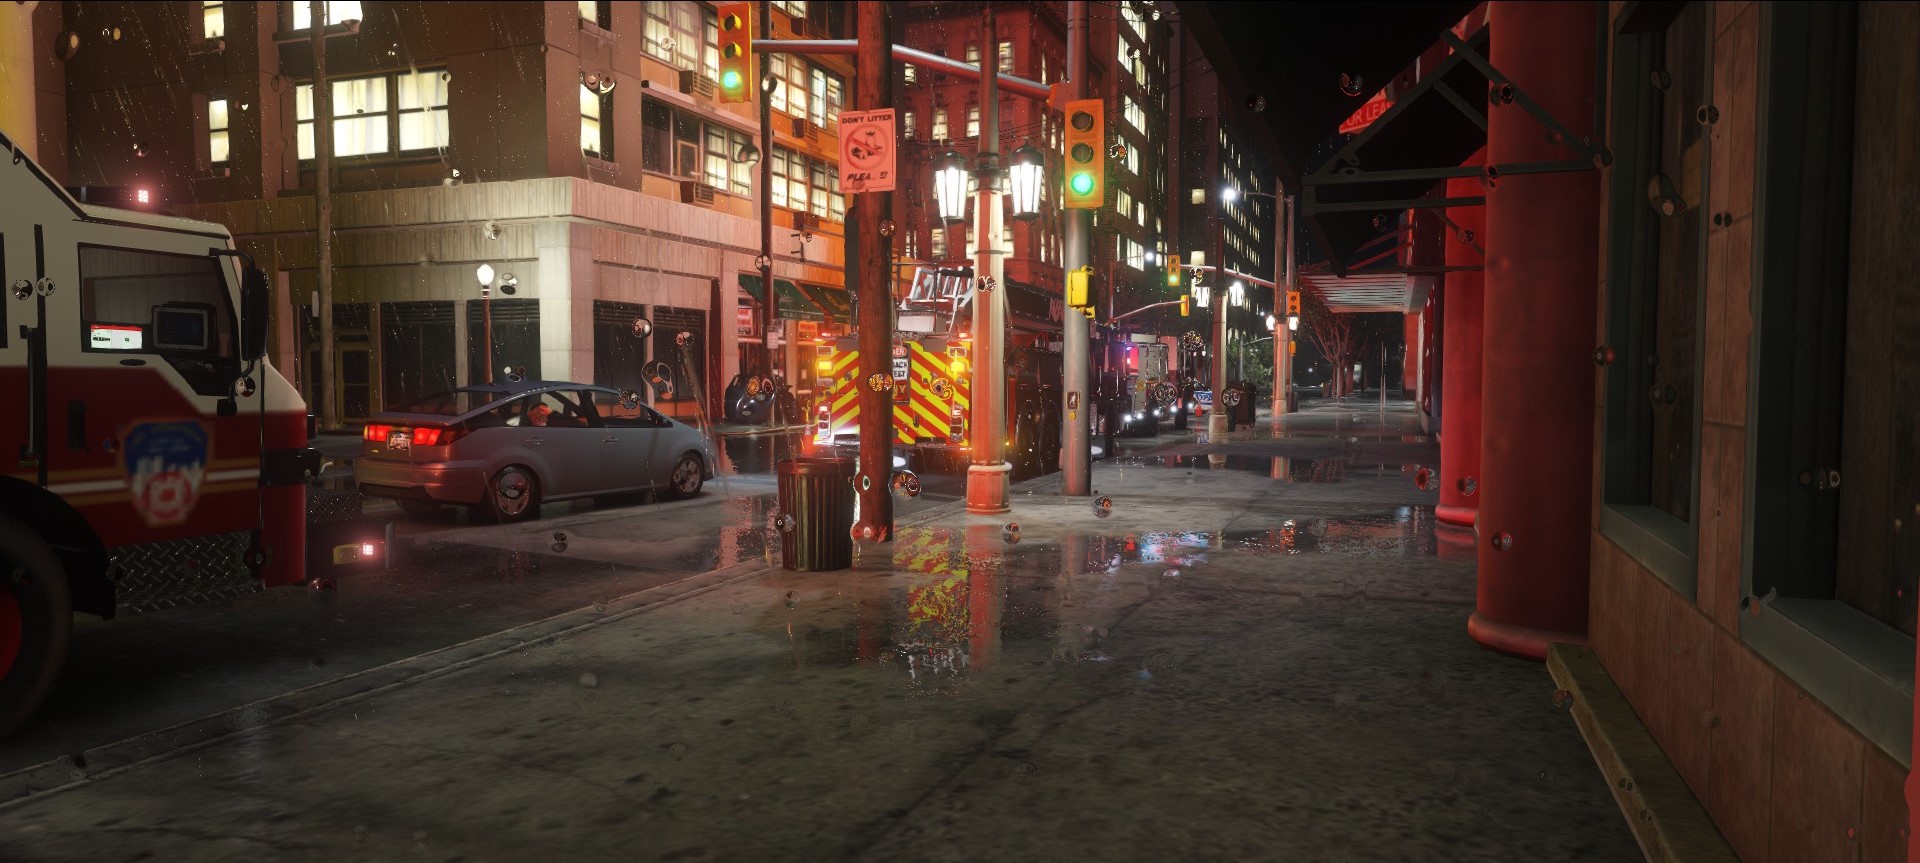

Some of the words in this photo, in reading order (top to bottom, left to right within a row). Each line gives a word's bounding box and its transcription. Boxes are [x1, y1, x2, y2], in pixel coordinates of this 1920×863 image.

[842, 116, 864, 124] DON'T
[867, 114, 891, 122] LITTER
[893, 361, 908, 369] ACK
